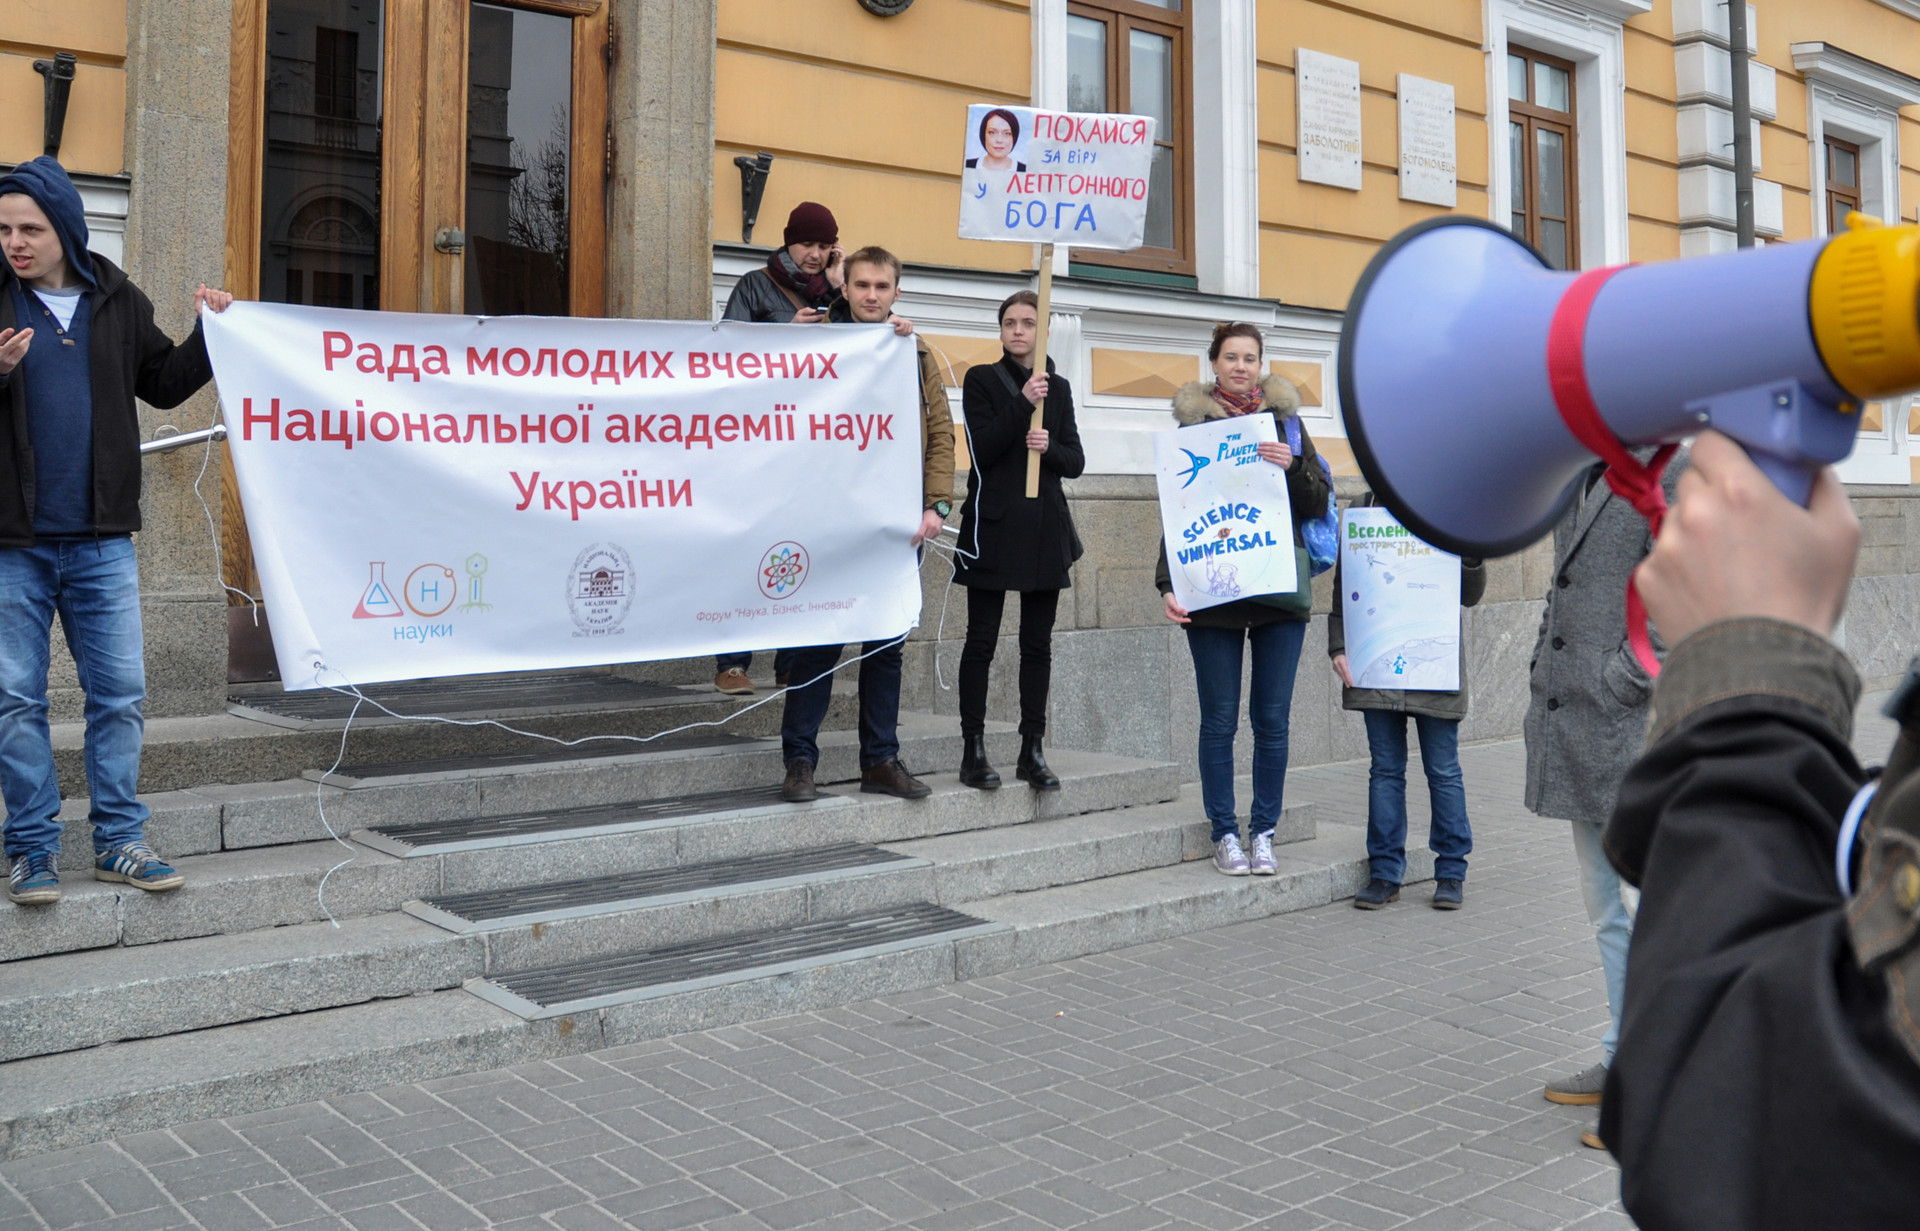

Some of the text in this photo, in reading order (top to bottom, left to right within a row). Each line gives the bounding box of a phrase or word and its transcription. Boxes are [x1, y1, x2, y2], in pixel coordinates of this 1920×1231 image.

[1034, 113, 1147, 146] ПОКАЙСЯ
[1303, 133, 1360, 154] ЗАБОЛОТНИЙ
[1041, 150, 1061, 164] ЗА
[1403, 153, 1456, 175] БОГОМОЛЕЦЬ
[1006, 173, 1146, 200] ЛЕПТОННОГО
[1005, 200, 1097, 232] БОГА
[323, 331, 839, 385] Рада молодих вчених
[243, 398, 894, 451] Національної академії наук
[1226, 433, 1242, 442] THE
[1216, 443, 1263, 462] PLANETA
[1235, 454, 1265, 466] SOCIET
[510, 470, 693, 521] України
[1183, 503, 1262, 544] SCIENCE
[1177, 531, 1277, 565] UNIVERSAL
[584, 599, 618, 607] АКАДЕМІЯ
[696, 610, 731, 624] Форум
[393, 624, 454, 644] науки
